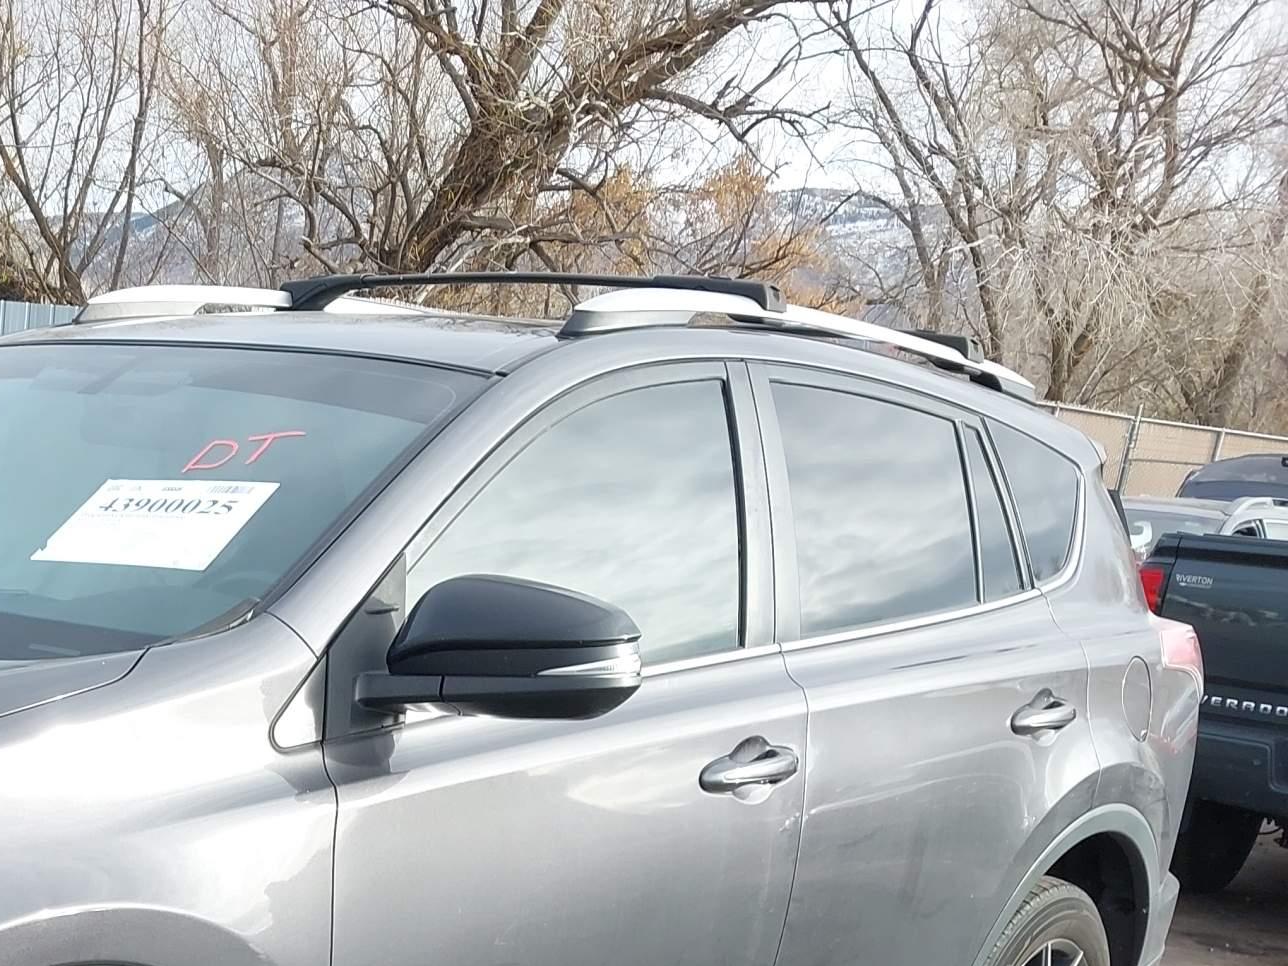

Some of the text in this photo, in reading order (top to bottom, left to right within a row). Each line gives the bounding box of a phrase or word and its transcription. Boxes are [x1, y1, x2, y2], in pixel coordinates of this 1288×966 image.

[181, 431, 307, 474] DT
[98, 497, 240, 515] 43900025
[1175, 573, 1214, 585] RIVERTON
